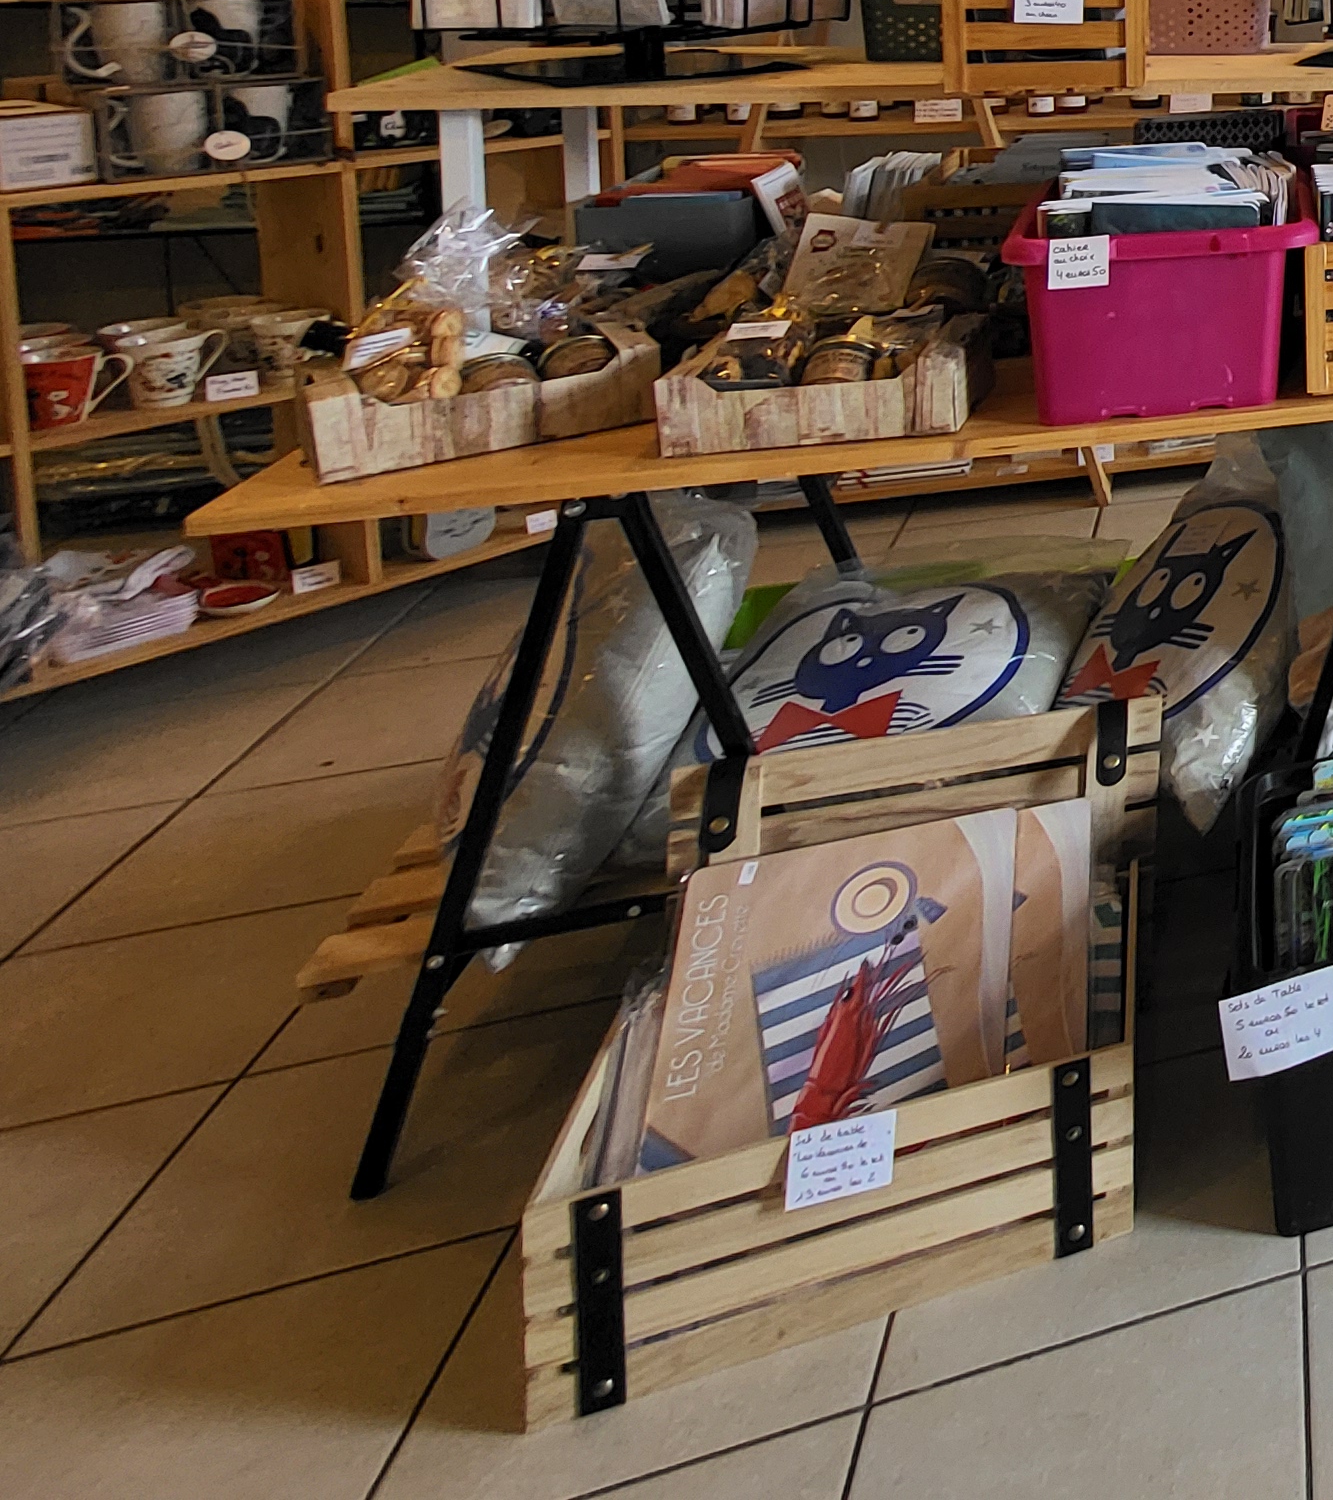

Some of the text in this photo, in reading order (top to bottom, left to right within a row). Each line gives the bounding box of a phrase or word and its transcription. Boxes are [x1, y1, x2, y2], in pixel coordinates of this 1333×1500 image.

[1055, 269, 1064, 280] 4
[1092, 265, 1107, 277] 50
[664, 893, 730, 1102] LES VACANCES
[1271, 982, 1302, 999] Table
[1235, 1019, 1246, 1032] 5
[1313, 1027, 1321, 1039] 4
[800, 1166, 810, 1179] 6
